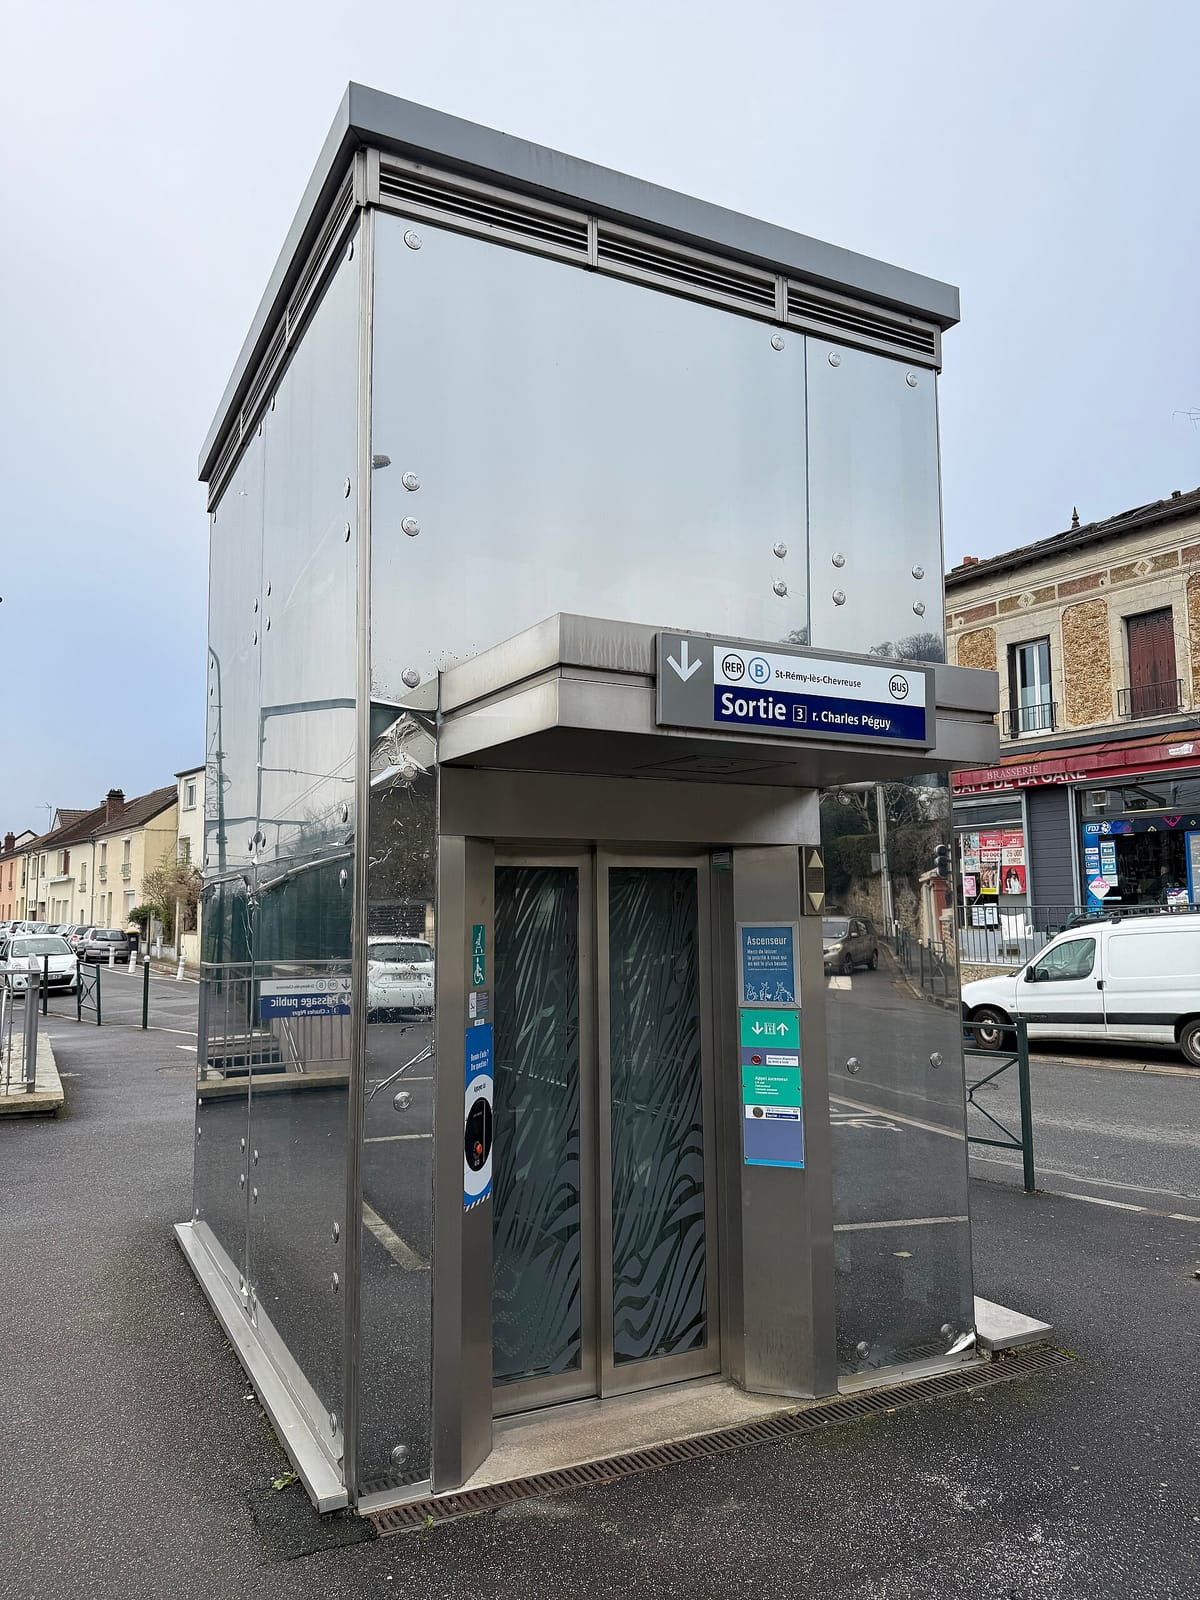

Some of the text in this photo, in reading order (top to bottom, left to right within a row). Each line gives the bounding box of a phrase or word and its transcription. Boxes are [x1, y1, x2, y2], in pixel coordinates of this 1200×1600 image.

[725, 661, 907, 693] RER B St-Rémy-lès-Chevreuse BUS
[721, 692, 891, 731] Sortie 3 r. Charles Péguy
[986, 765, 1040, 780] BRASSERIE
[994, 778, 1014, 789] DE
[1017, 773, 1038, 786] LA
[1041, 769, 1087, 783] GARE
[746, 935, 788, 946] Ascenseur
